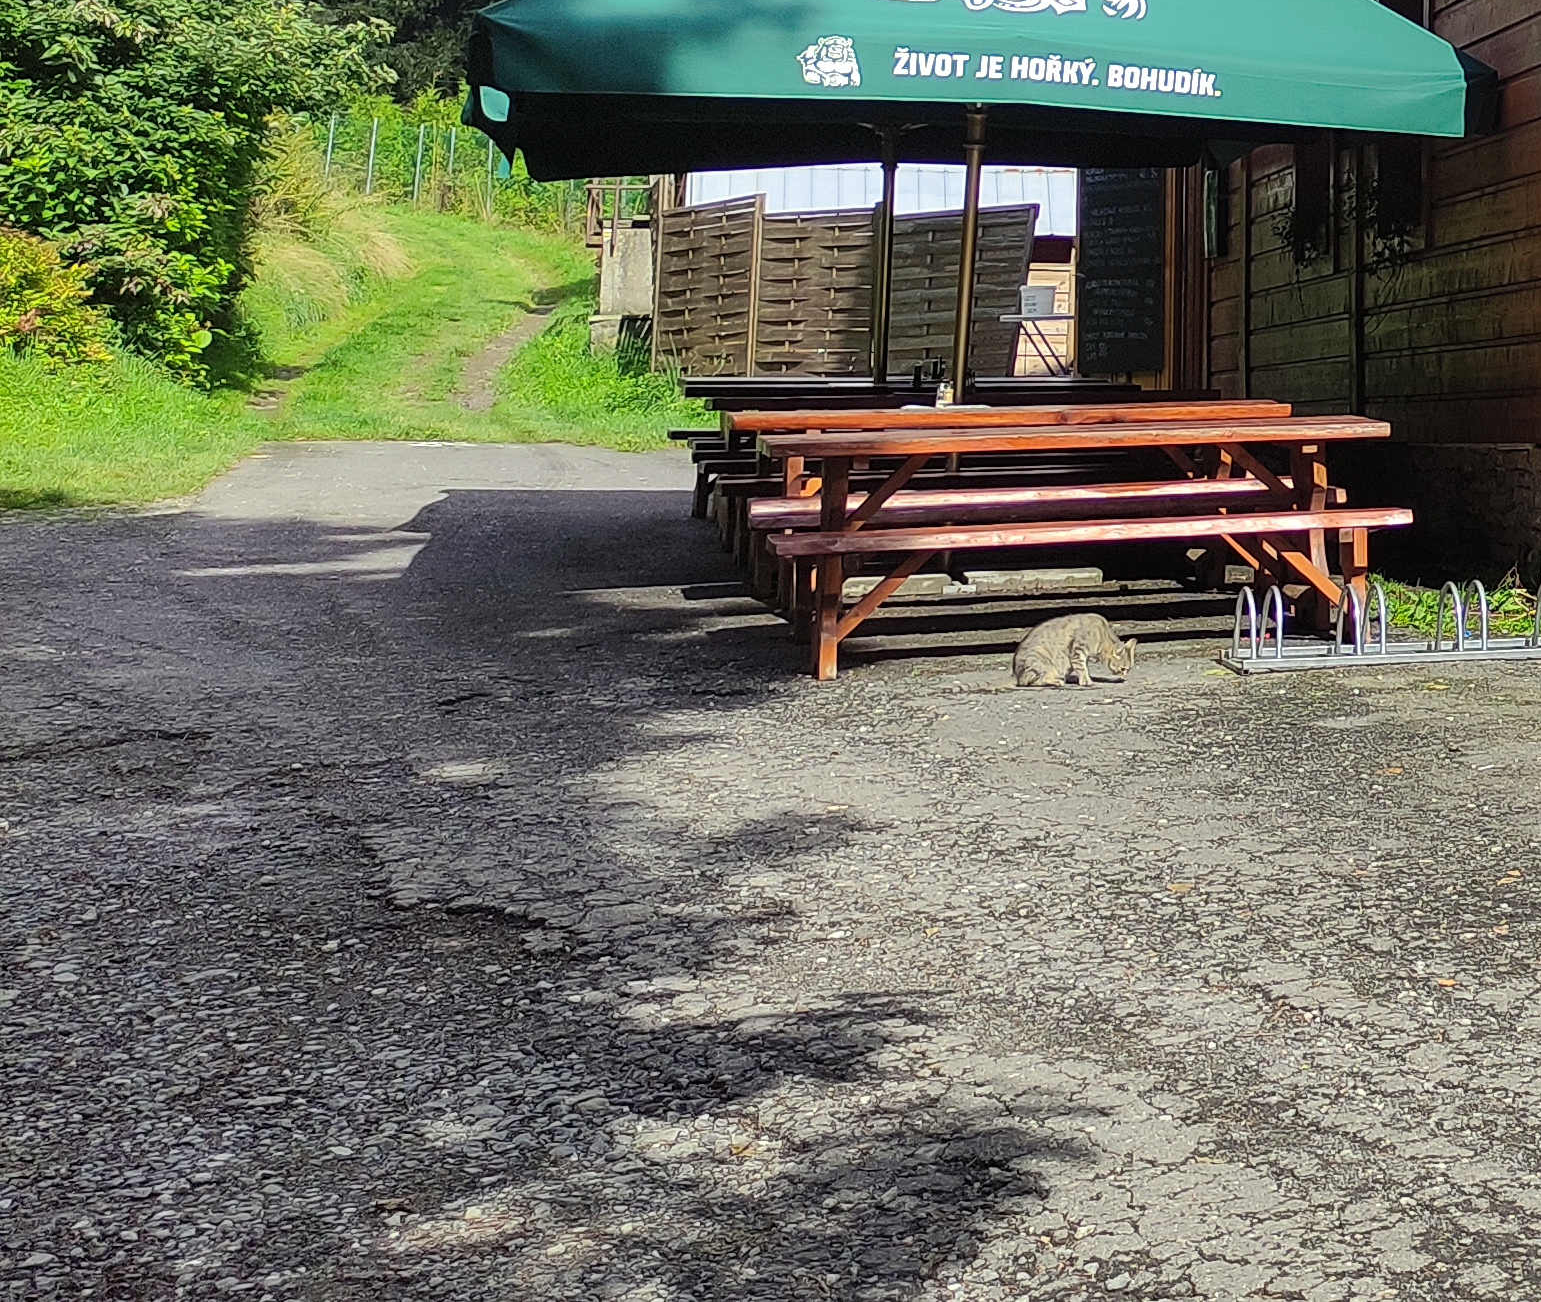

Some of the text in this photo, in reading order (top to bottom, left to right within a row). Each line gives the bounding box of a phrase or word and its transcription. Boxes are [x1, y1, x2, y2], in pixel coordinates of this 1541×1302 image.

[892, 46, 1223, 98] ŽIVOT JE HOŘKÝ. BOHUDÍK.
